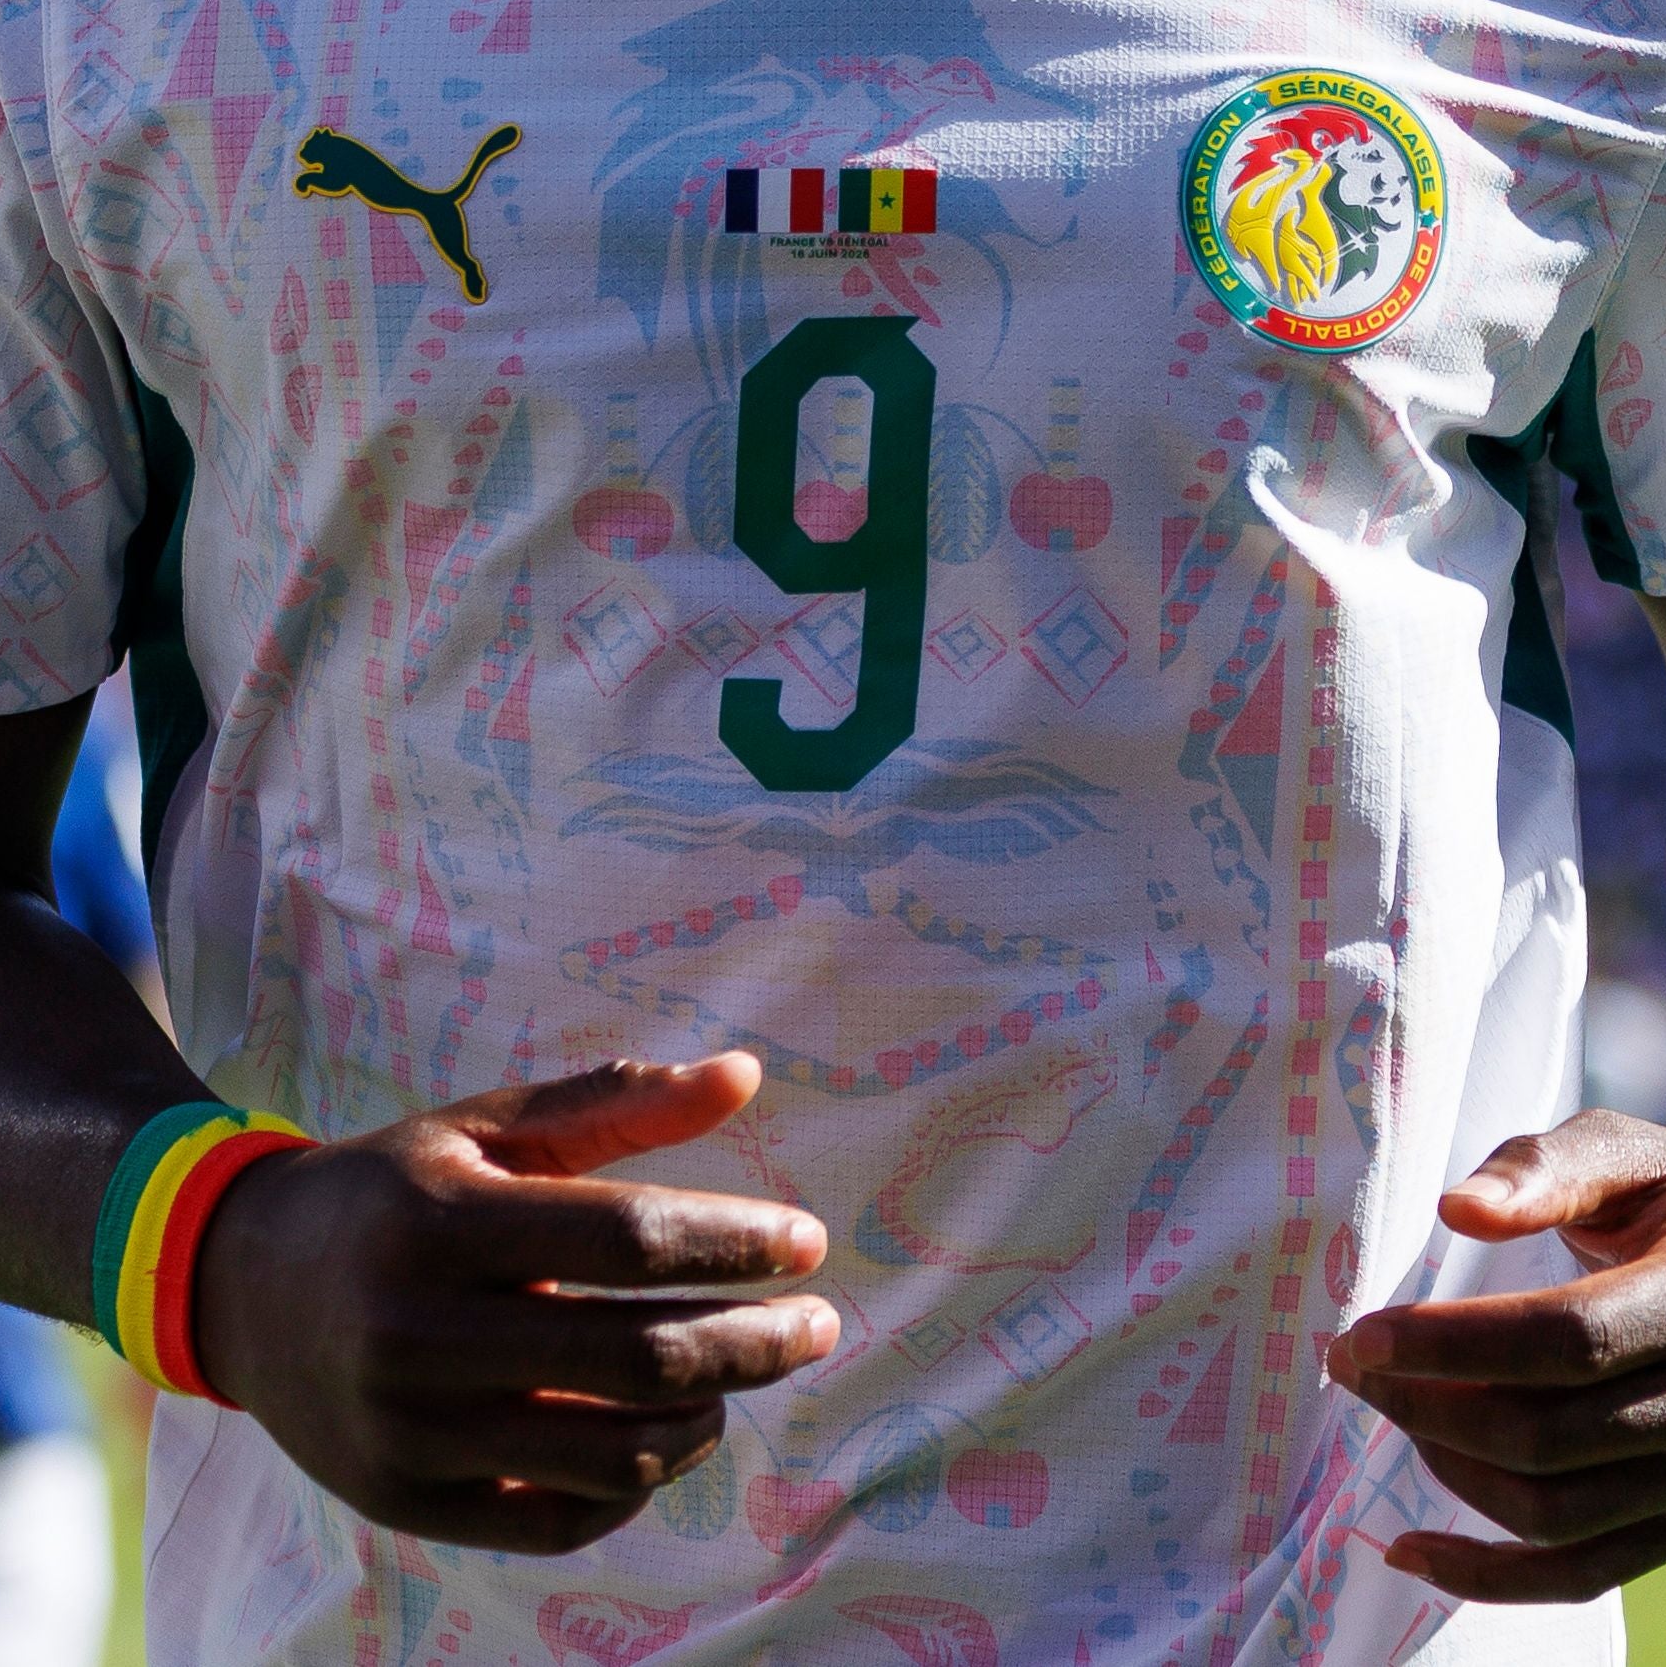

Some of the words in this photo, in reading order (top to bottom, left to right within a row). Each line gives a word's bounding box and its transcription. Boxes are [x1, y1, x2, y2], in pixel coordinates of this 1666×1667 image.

[1278, 76, 1436, 194] SÉNÉGALAISE
[1190, 111, 1242, 292] FÉDÉRATION
[769, 236, 815, 247] FRANCE
[808, 248, 838, 259] JUIN
[1409, 246, 1433, 284] DE
[1283, 286, 1412, 340] FOOTBALL
[718, 315, 937, 792] 9
